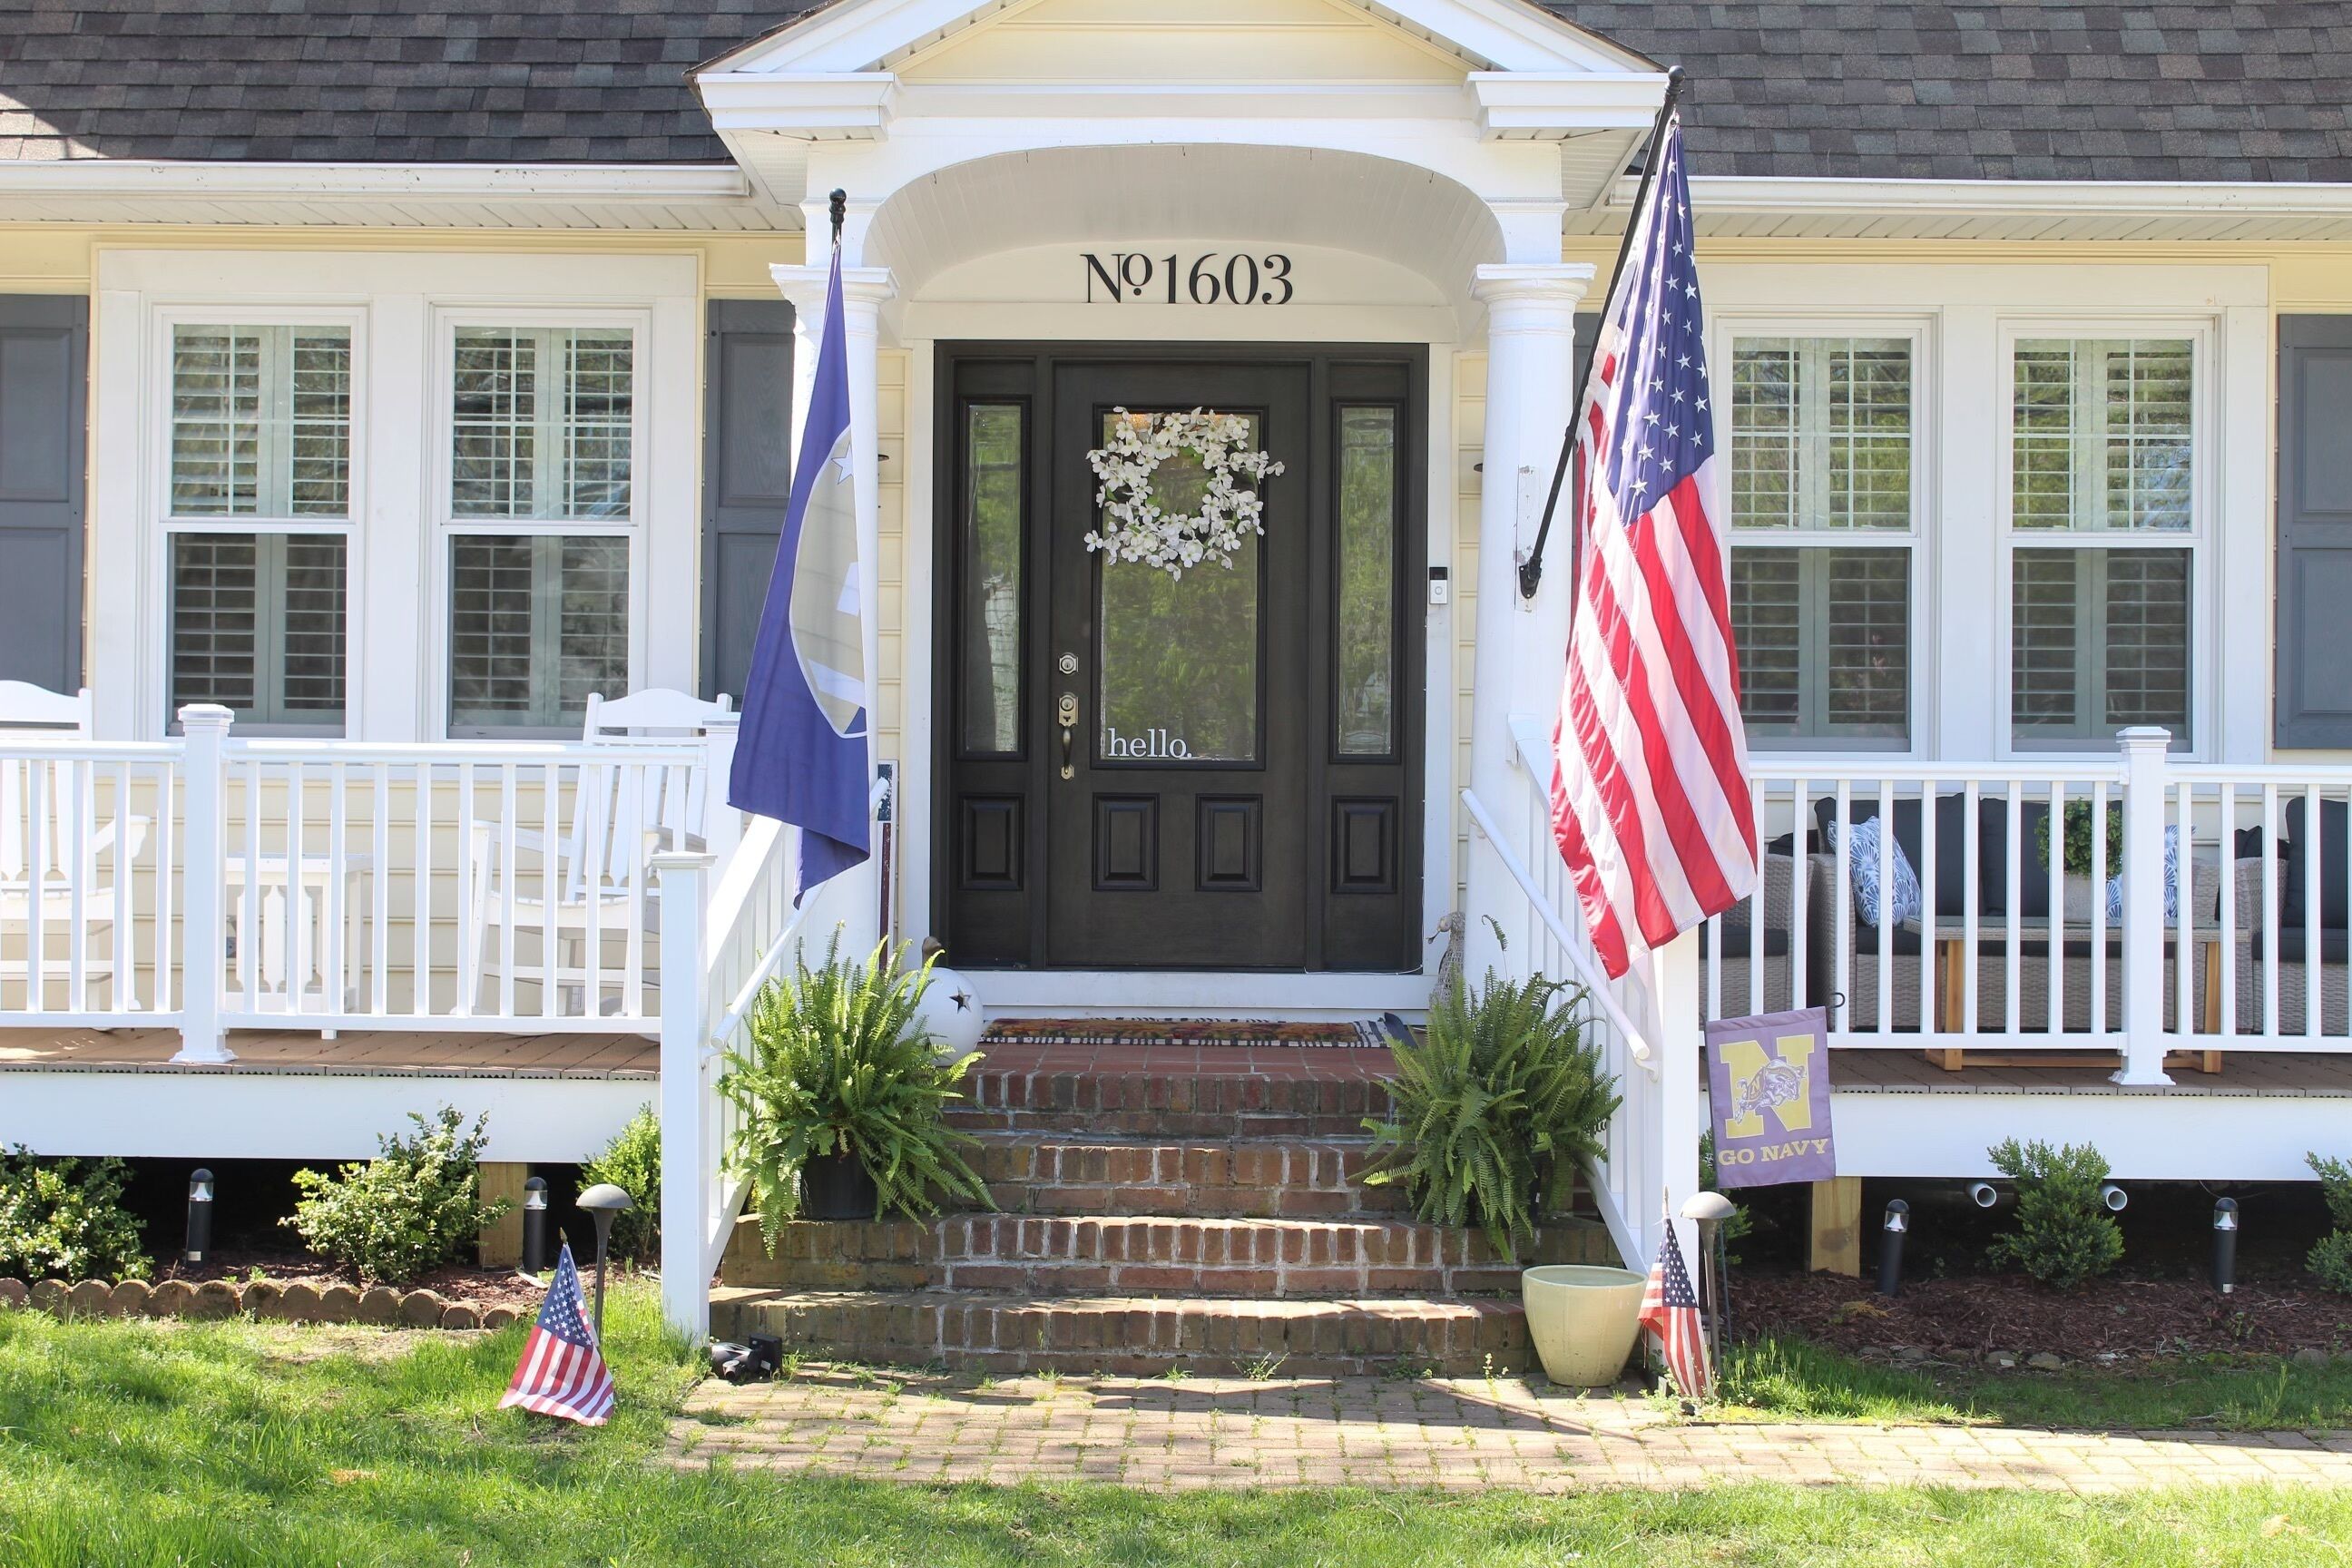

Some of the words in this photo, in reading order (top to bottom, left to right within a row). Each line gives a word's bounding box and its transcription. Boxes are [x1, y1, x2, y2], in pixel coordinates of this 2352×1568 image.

[1720, 1034, 1814, 1138] N
[1718, 1148, 1755, 1166] GO
[1760, 1138, 1829, 1162] NAVY
